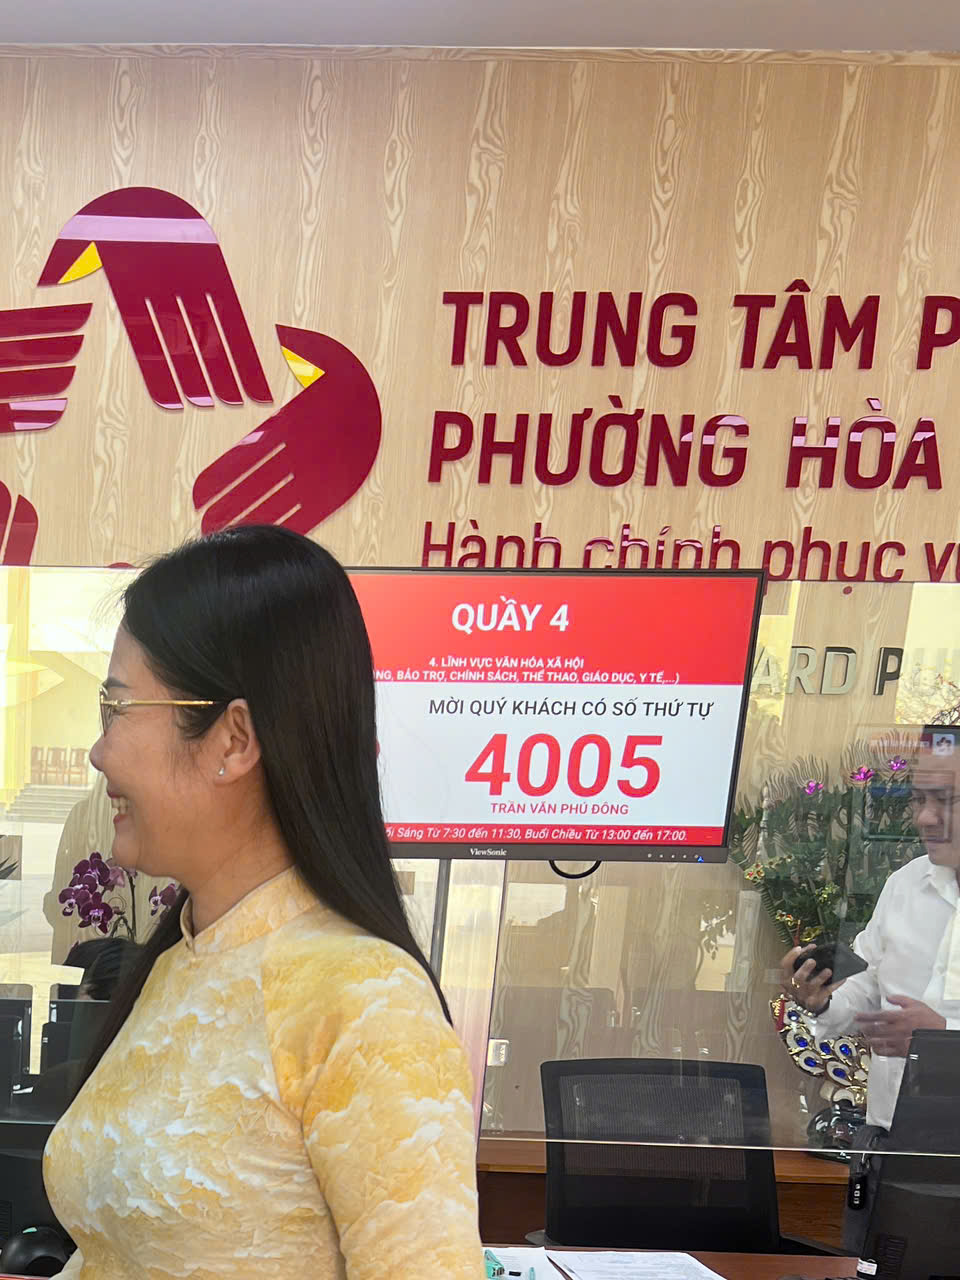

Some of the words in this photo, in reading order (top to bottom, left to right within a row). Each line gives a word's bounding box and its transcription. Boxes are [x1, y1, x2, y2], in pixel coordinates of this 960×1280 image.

[442, 291, 698, 368] TRUNG
[733, 279, 881, 371] TÂM
[427, 395, 750, 488] PHƯỜNG
[785, 398, 943, 490] HÒA
[421, 520, 561, 569] Hành
[583, 524, 741, 570] chính
[761, 526, 905, 596] phục
[451, 595, 543, 634] QUẦY
[549, 604, 569, 631] 4
[428, 657, 439, 668] 4.
[441, 656, 467, 668] LĨNH
[469, 657, 493, 670] VỰC
[495, 656, 518, 668] VĂN
[520, 656, 544, 669] HÓA
[545, 656, 565, 669] XÃ
[565, 657, 584, 670] HỘI
[450, 669, 485, 682] CHÍNH
[487, 669, 519, 683] SÁCH,
[547, 671, 580, 684] THAO,
[582, 670, 610, 683] GIÁO
[639, 672, 648, 683] Y
[429, 696, 464, 714] MỜI
[470, 696, 507, 717] QUÝ
[511, 697, 576, 716] KHÁCH
[581, 697, 608, 716] CÓ
[612, 697, 639, 716] SỐ
[642, 698, 684, 717] THỨ
[688, 701, 714, 720] TỰ
[464, 733, 663, 799] 4005
[491, 801, 527, 814] TRẦN
[397, 827, 423, 841] Sáng
[426, 827, 441, 838] Từ
[443, 828, 466, 839] 7:30
[468, 828, 489, 840] đến
[491, 828, 522, 842] 11:30,
[524, 828, 548, 840] Buổi
[551, 828, 582, 841] Chiều
[585, 829, 599, 841] Từ
[602, 830, 630, 841] 13:00
[632, 830, 653, 842] đến
[469, 848, 507, 857] ViewSonic
